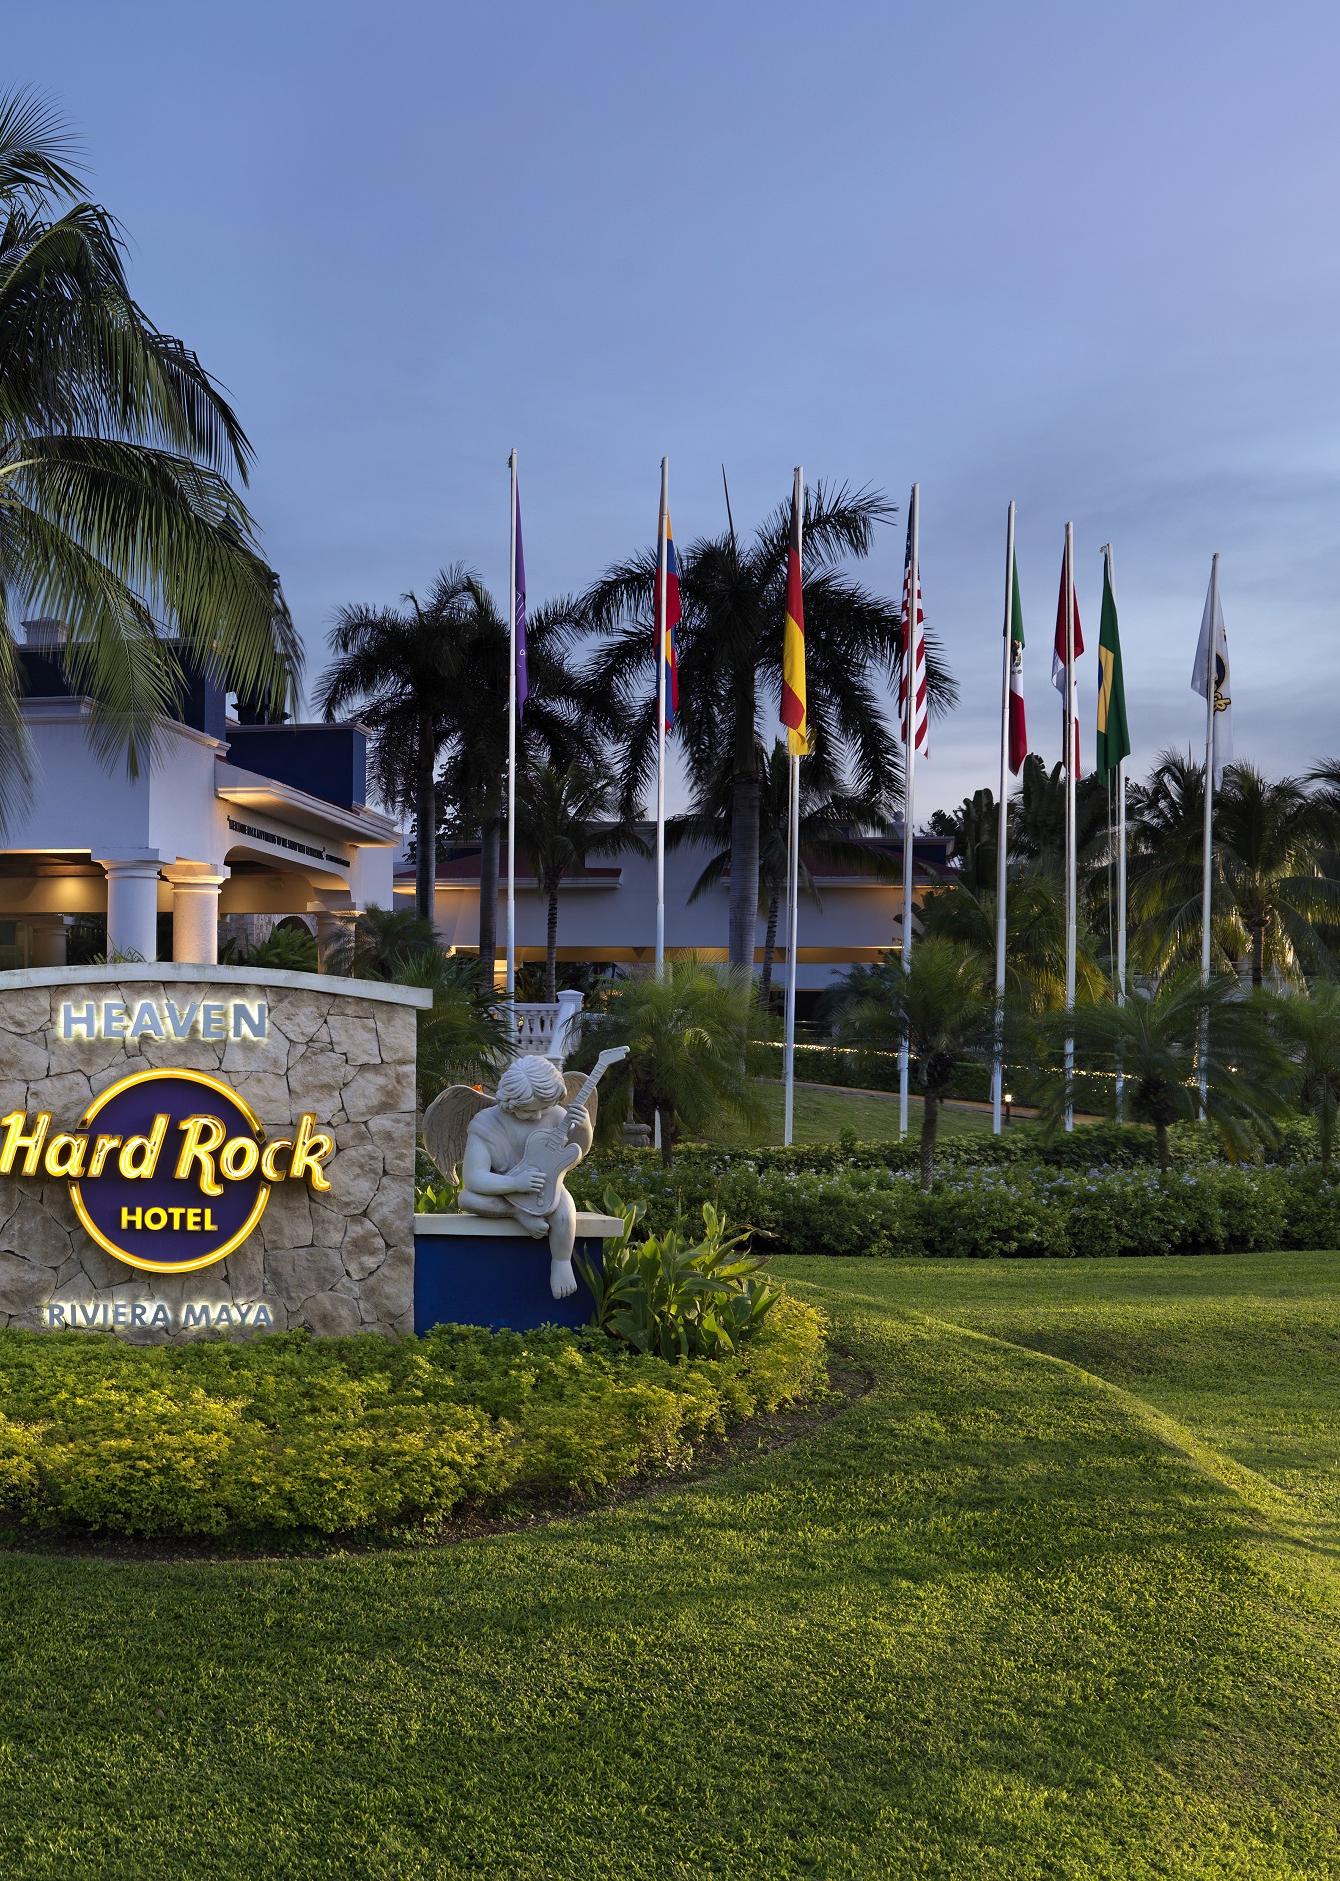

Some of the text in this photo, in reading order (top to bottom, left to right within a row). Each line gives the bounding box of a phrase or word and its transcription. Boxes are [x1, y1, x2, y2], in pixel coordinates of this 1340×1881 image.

[62, 1001, 268, 1039] HEAVEN
[172, 1112, 336, 1197] Rock
[120, 1206, 219, 1232] HOTEL
[47, 1303, 274, 1327] RIVIERA MAYA
